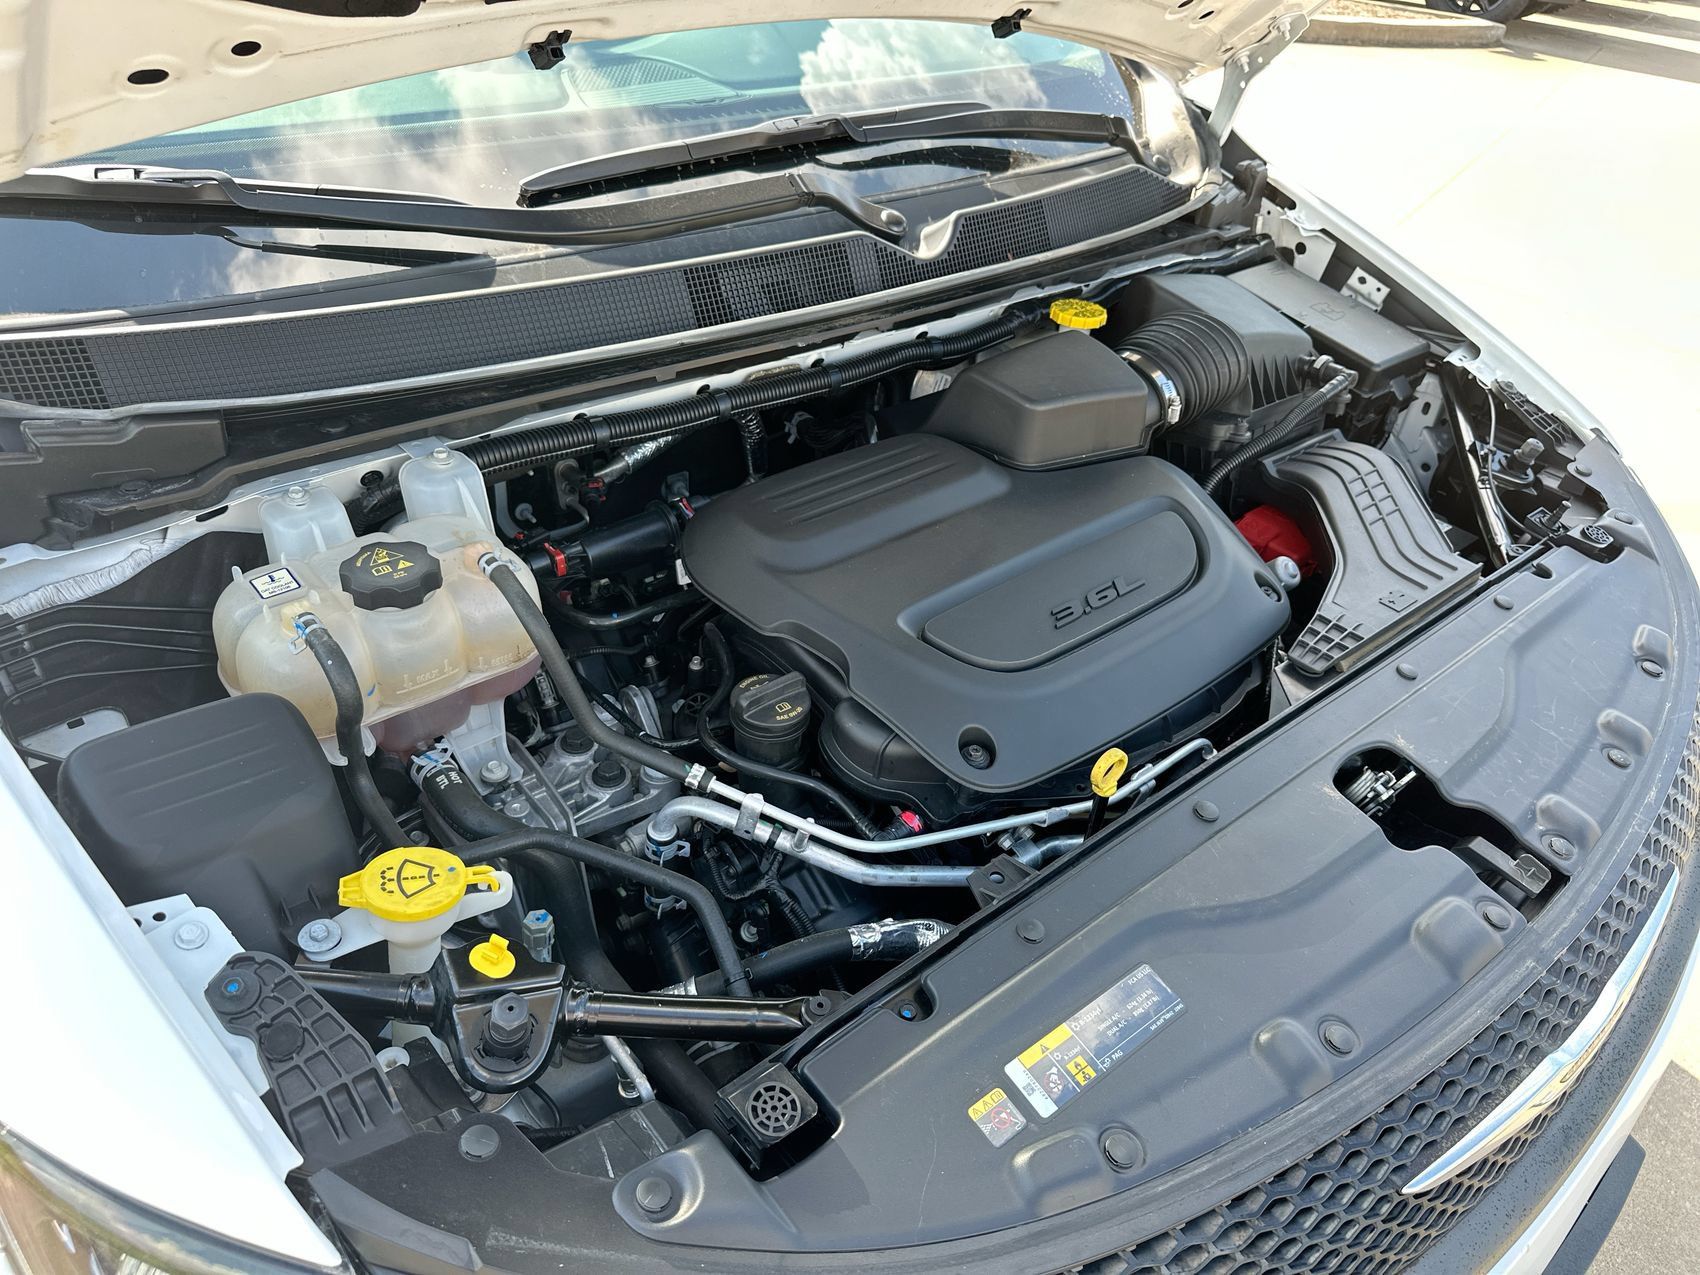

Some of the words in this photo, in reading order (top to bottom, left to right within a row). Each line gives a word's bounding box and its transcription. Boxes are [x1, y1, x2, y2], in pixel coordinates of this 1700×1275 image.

[1050, 575, 1146, 631] 3.6L
[448, 771, 464, 784] HOT
[1112, 1050, 1124, 1061] PAG
